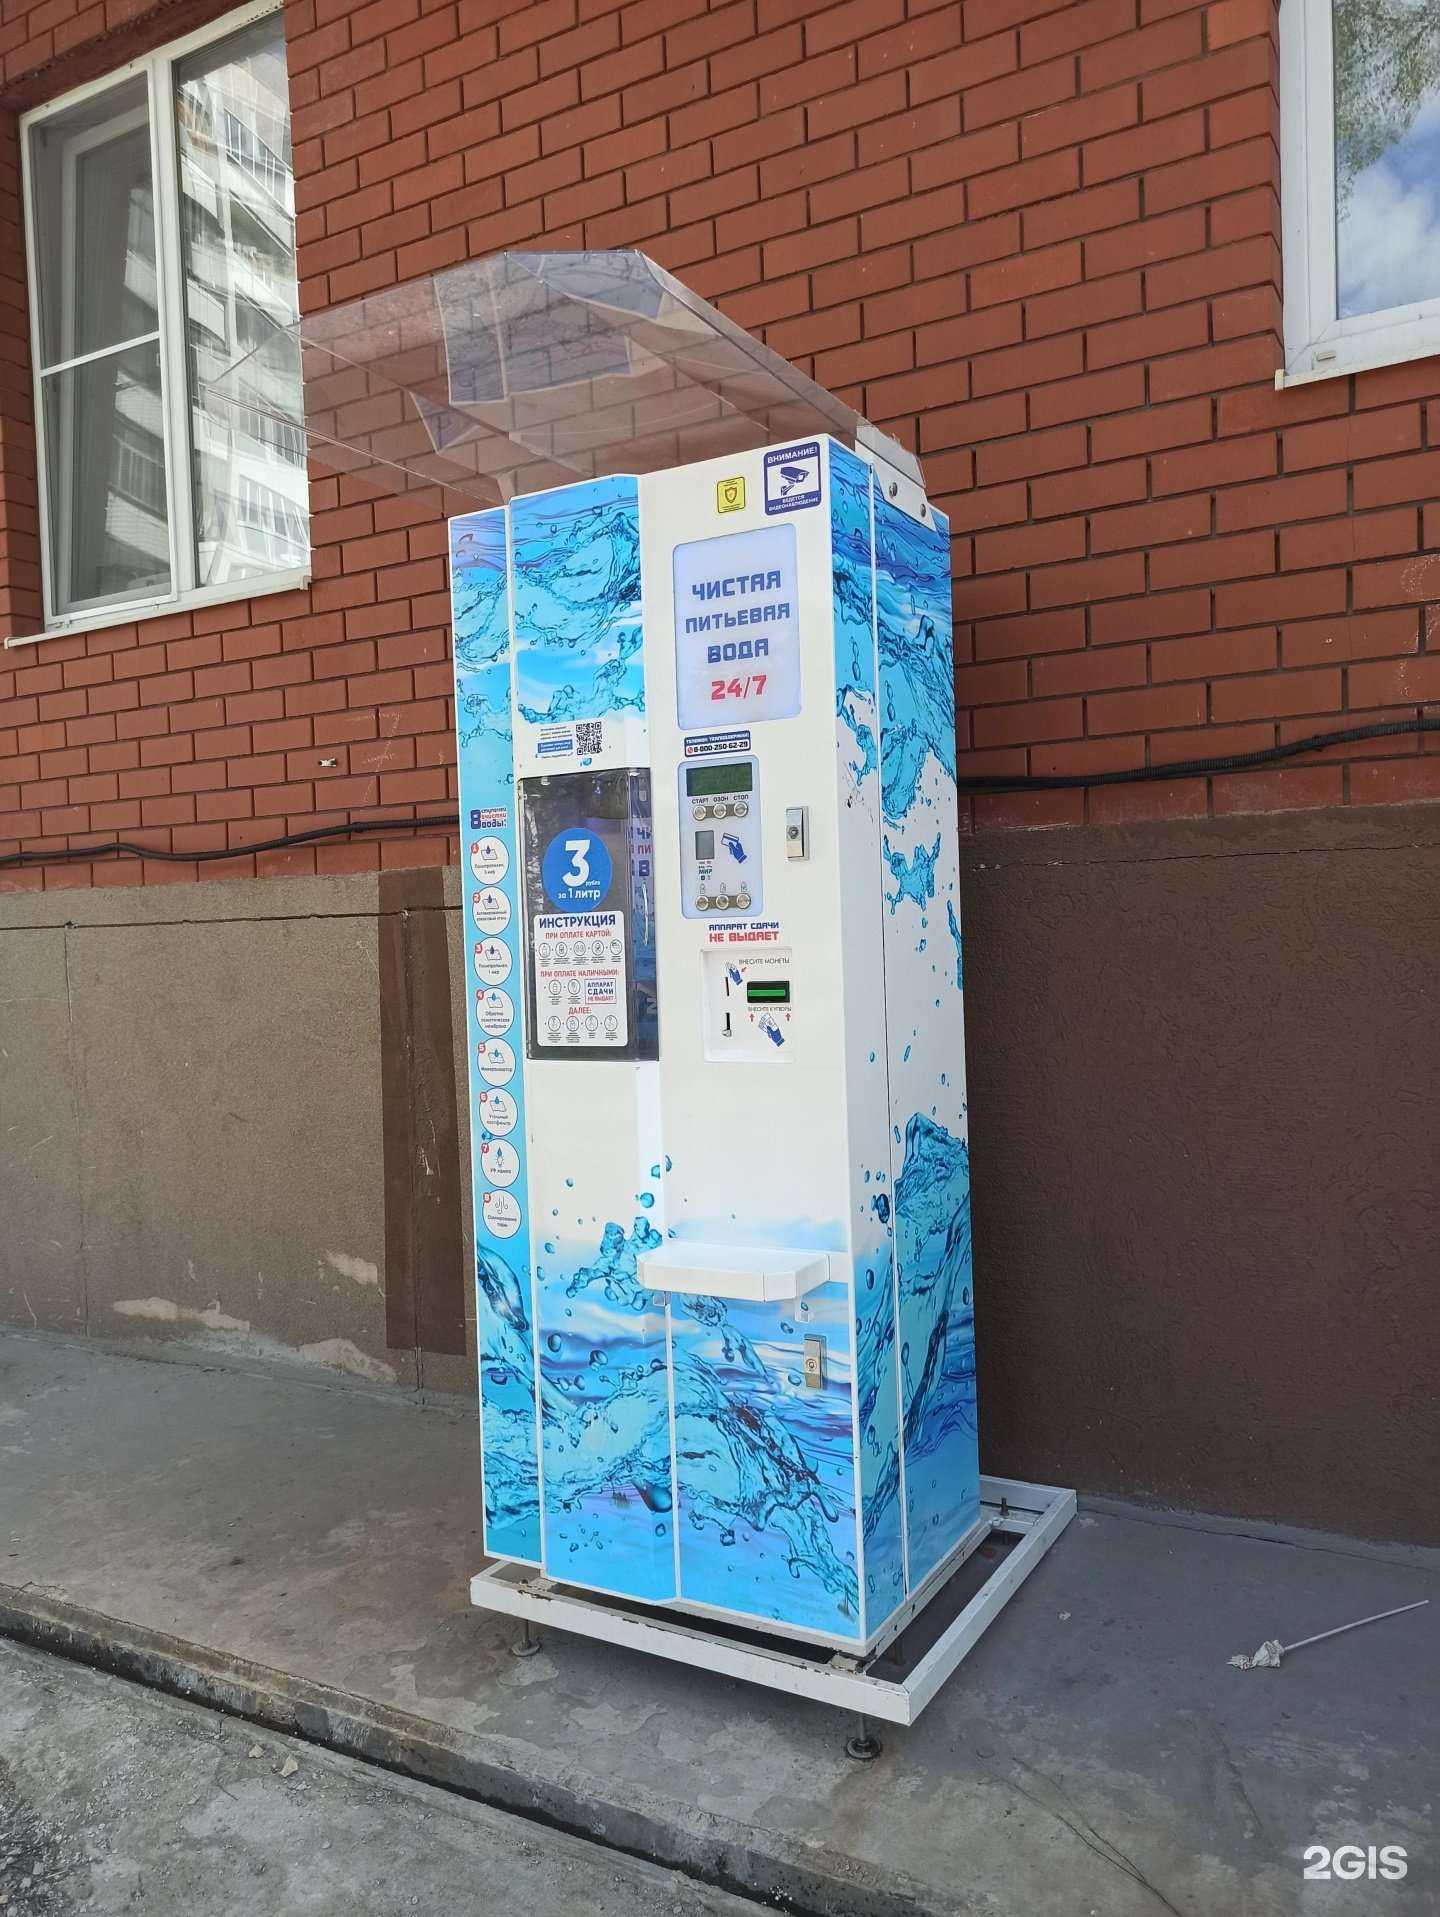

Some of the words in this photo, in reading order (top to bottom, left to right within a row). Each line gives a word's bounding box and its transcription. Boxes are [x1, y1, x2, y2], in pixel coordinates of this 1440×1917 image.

[767, 446, 818, 464] ВНИМАНИЕ!
[692, 570, 781, 600] ЧИСТАЯ
[685, 602, 790, 633] ПИТЬЕВАЯ
[707, 638, 769, 664] ВОДА
[711, 674, 767, 700] 24/7
[562, 839, 591, 887] 3
[568, 889, 573, 898] 1
[575, 889, 601, 900] литр
[539, 914, 616, 928] ИНСТРУКЦИЯ
[709, 923, 747, 931] АППАРАТ
[751, 922, 779, 930] СДАЧИ
[545, 931, 558, 939] ПРИ
[560, 930, 584, 939] ОПЛАТЕ
[709, 933, 724, 942] НЕ
[728, 931, 779, 941] ВЫДАЕТ
[568, 1006, 592, 1015] ДАЛЕЕ:
